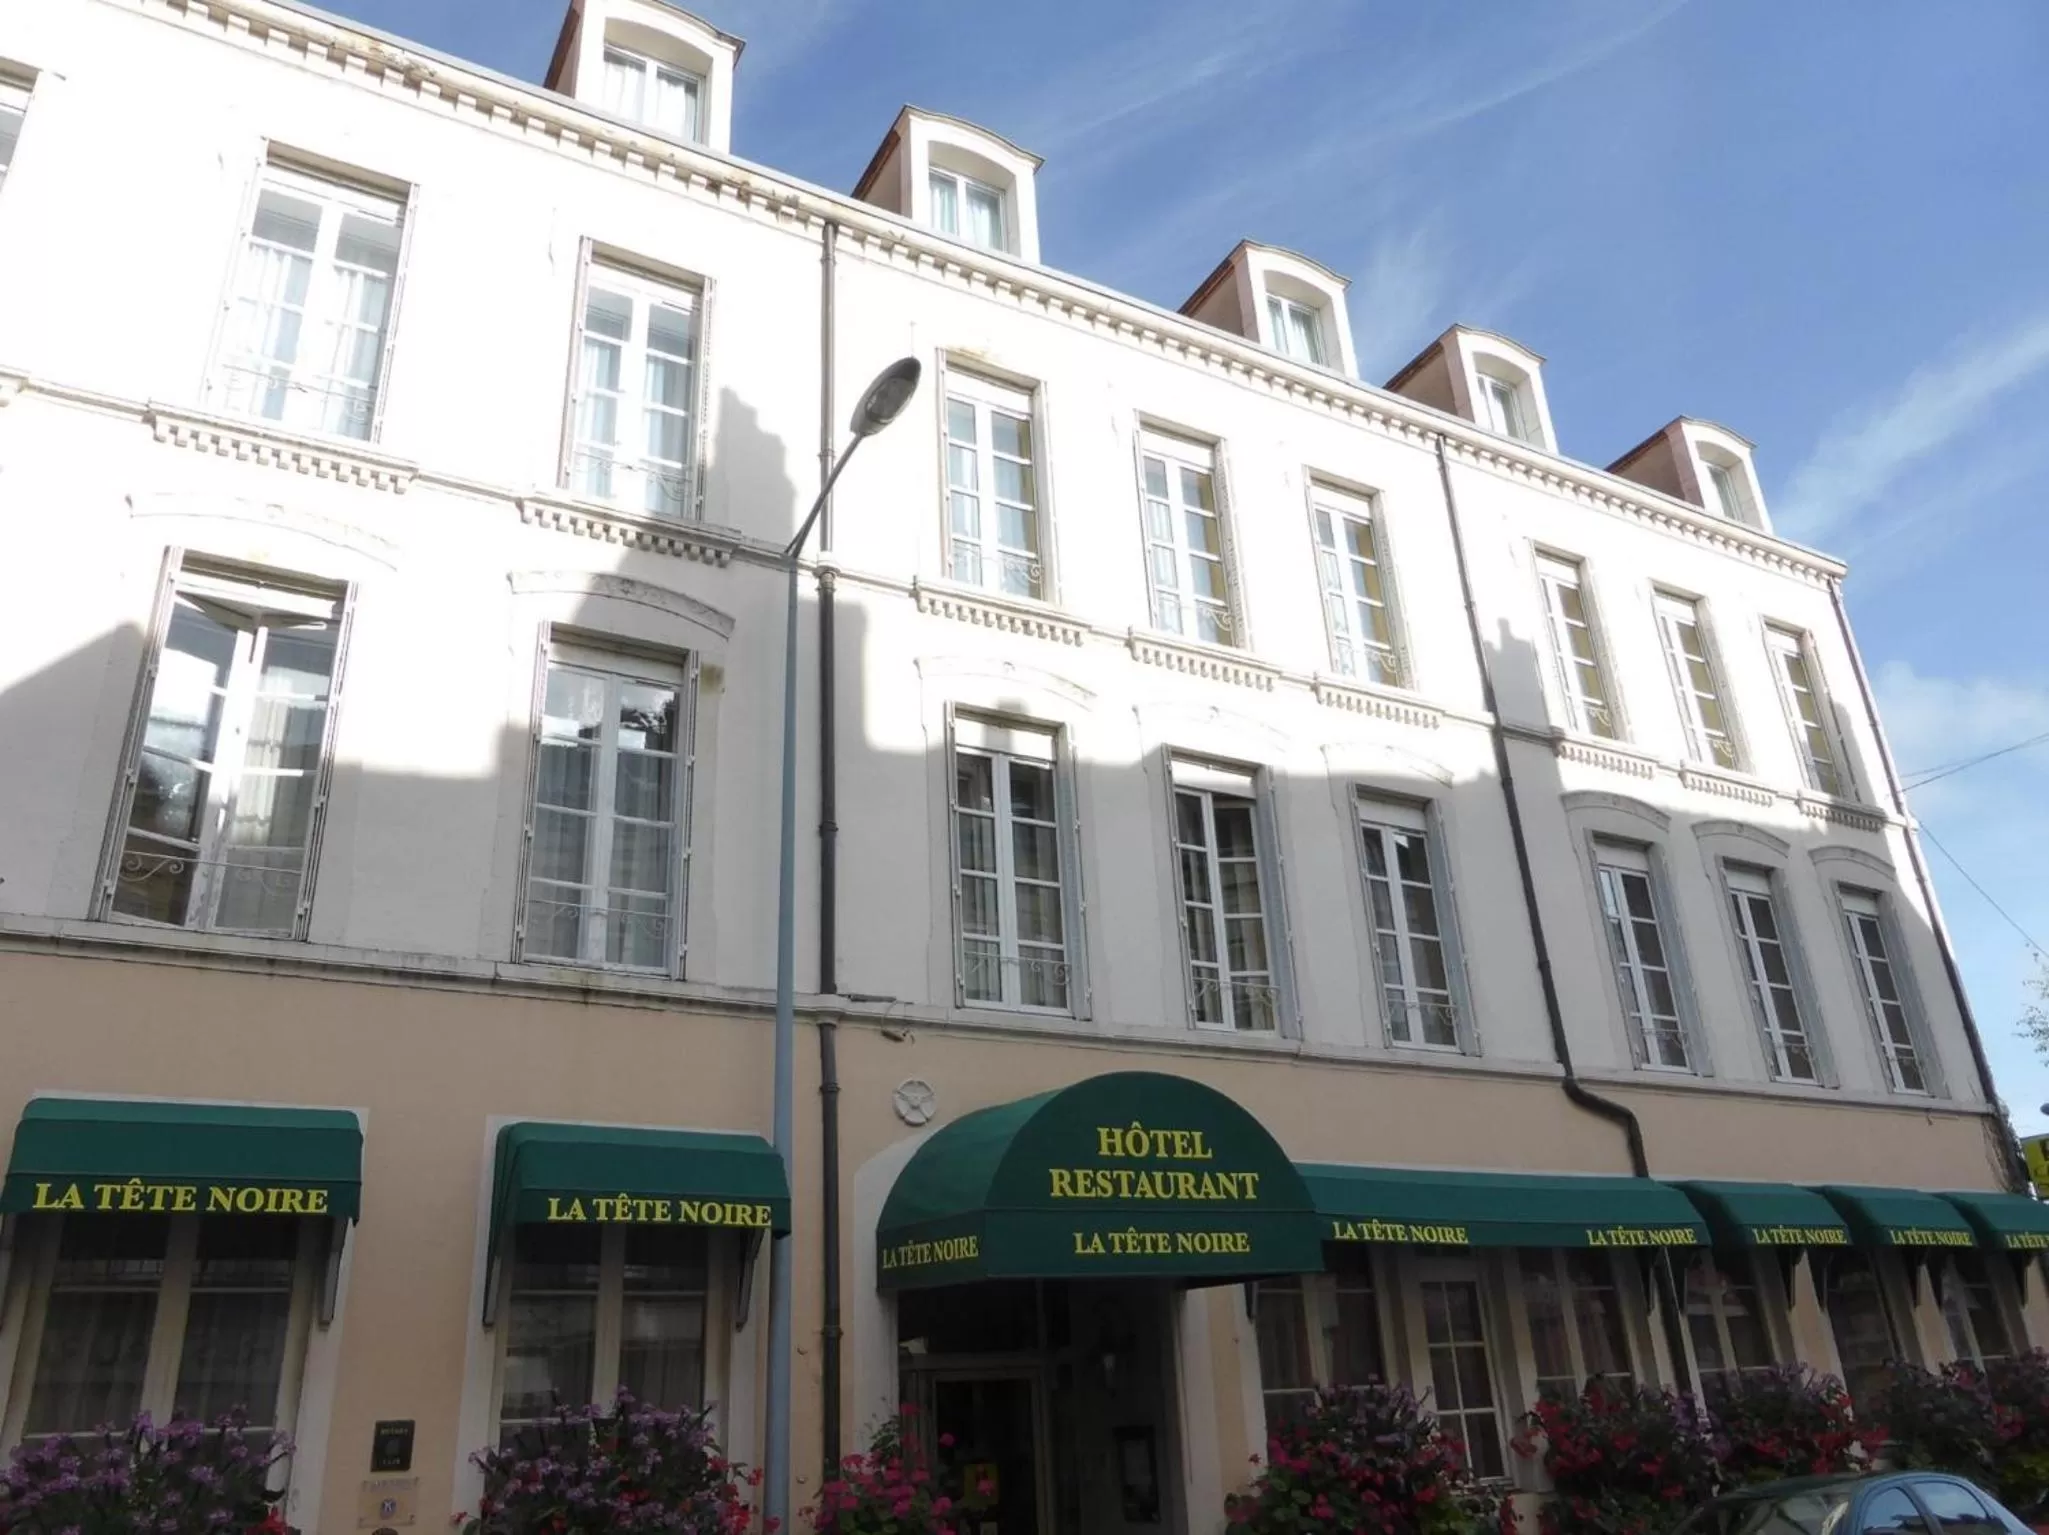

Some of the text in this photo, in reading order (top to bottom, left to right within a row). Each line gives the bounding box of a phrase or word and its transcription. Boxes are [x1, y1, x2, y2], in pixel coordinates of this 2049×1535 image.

[1096, 1121, 1213, 1159] HÔTEL
[32, 1177, 329, 1213] LA TÊTE NOIRE
[1049, 1168, 1260, 1200] RESTAURANT
[547, 1192, 772, 1227] LA TÊTE NOIRE
[1073, 1226, 1250, 1254] LA TÊTE NOIRE
[1332, 1218, 1469, 1244] LA TÊTE NOIRE
[1586, 1224, 1697, 1246] LA TÊTE NOIRE
[1752, 1223, 1847, 1245] LA TÊTE NOIRE
[1889, 1229, 1906, 1246] LA
[882, 1235, 979, 1269] LA TÊTE NOIRE
